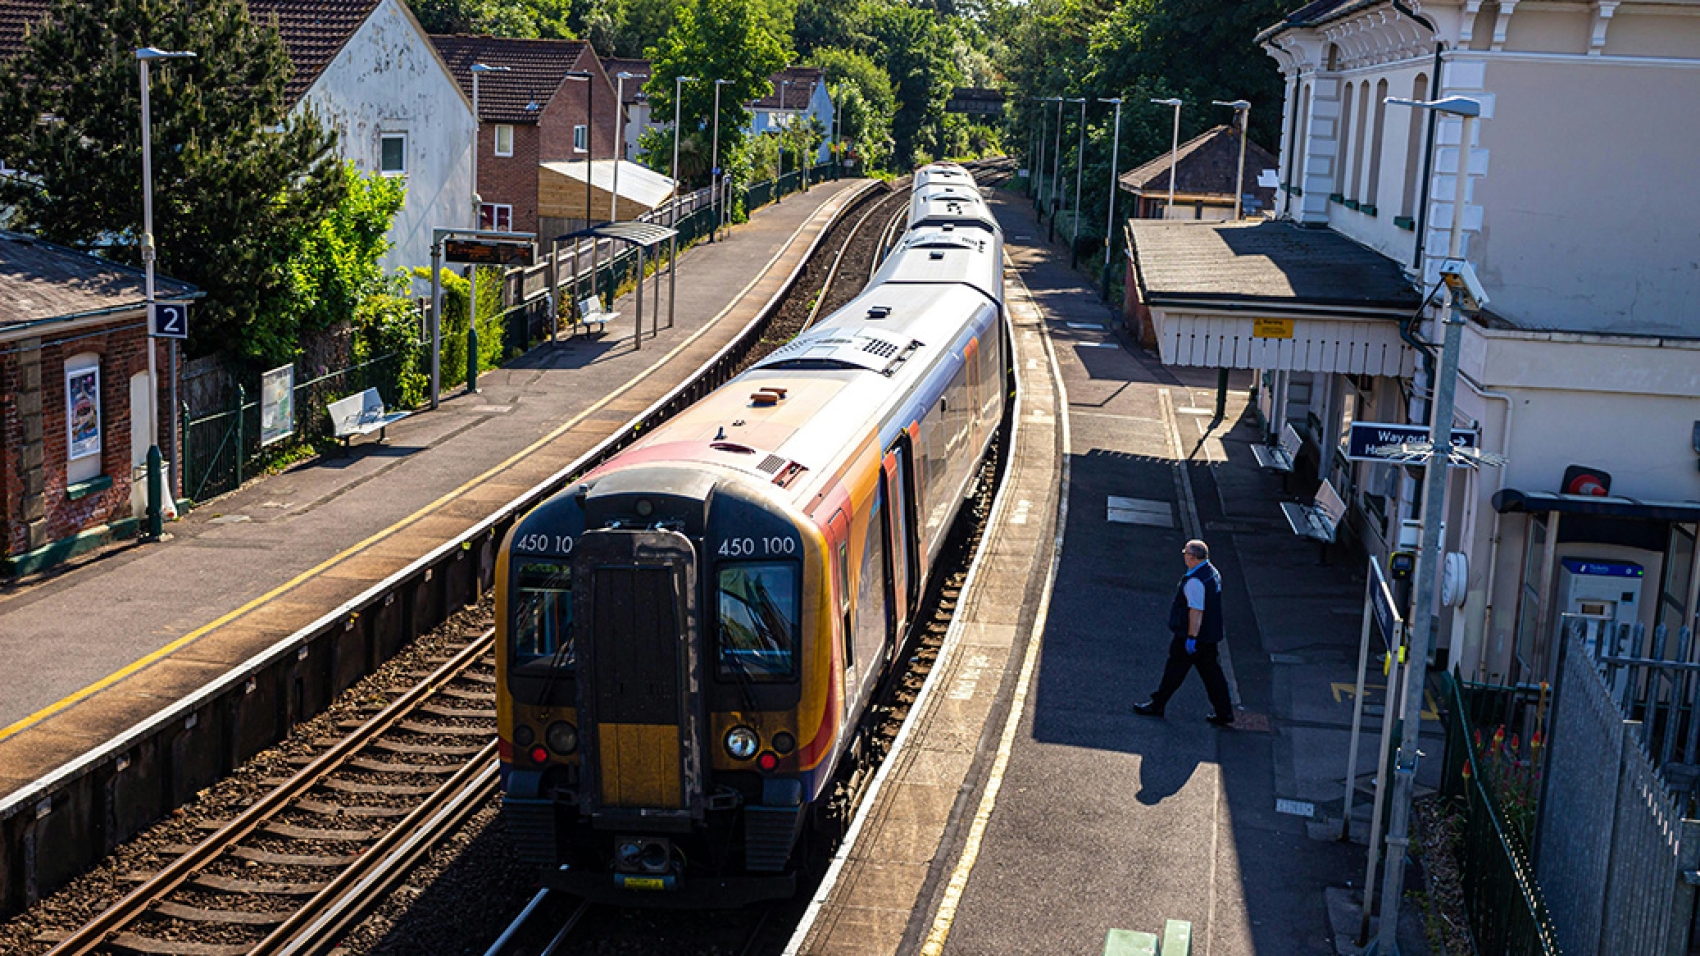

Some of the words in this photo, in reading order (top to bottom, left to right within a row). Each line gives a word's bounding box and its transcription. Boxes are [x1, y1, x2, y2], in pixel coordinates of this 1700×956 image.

[164, 307, 179, 331] 2
[1378, 431, 1404, 444] Way
[1406, 434, 1427, 443] out
[517, 534, 548, 552] 450
[555, 536, 573, 554] 10
[717, 537, 755, 556] 450
[762, 536, 796, 554] 100
